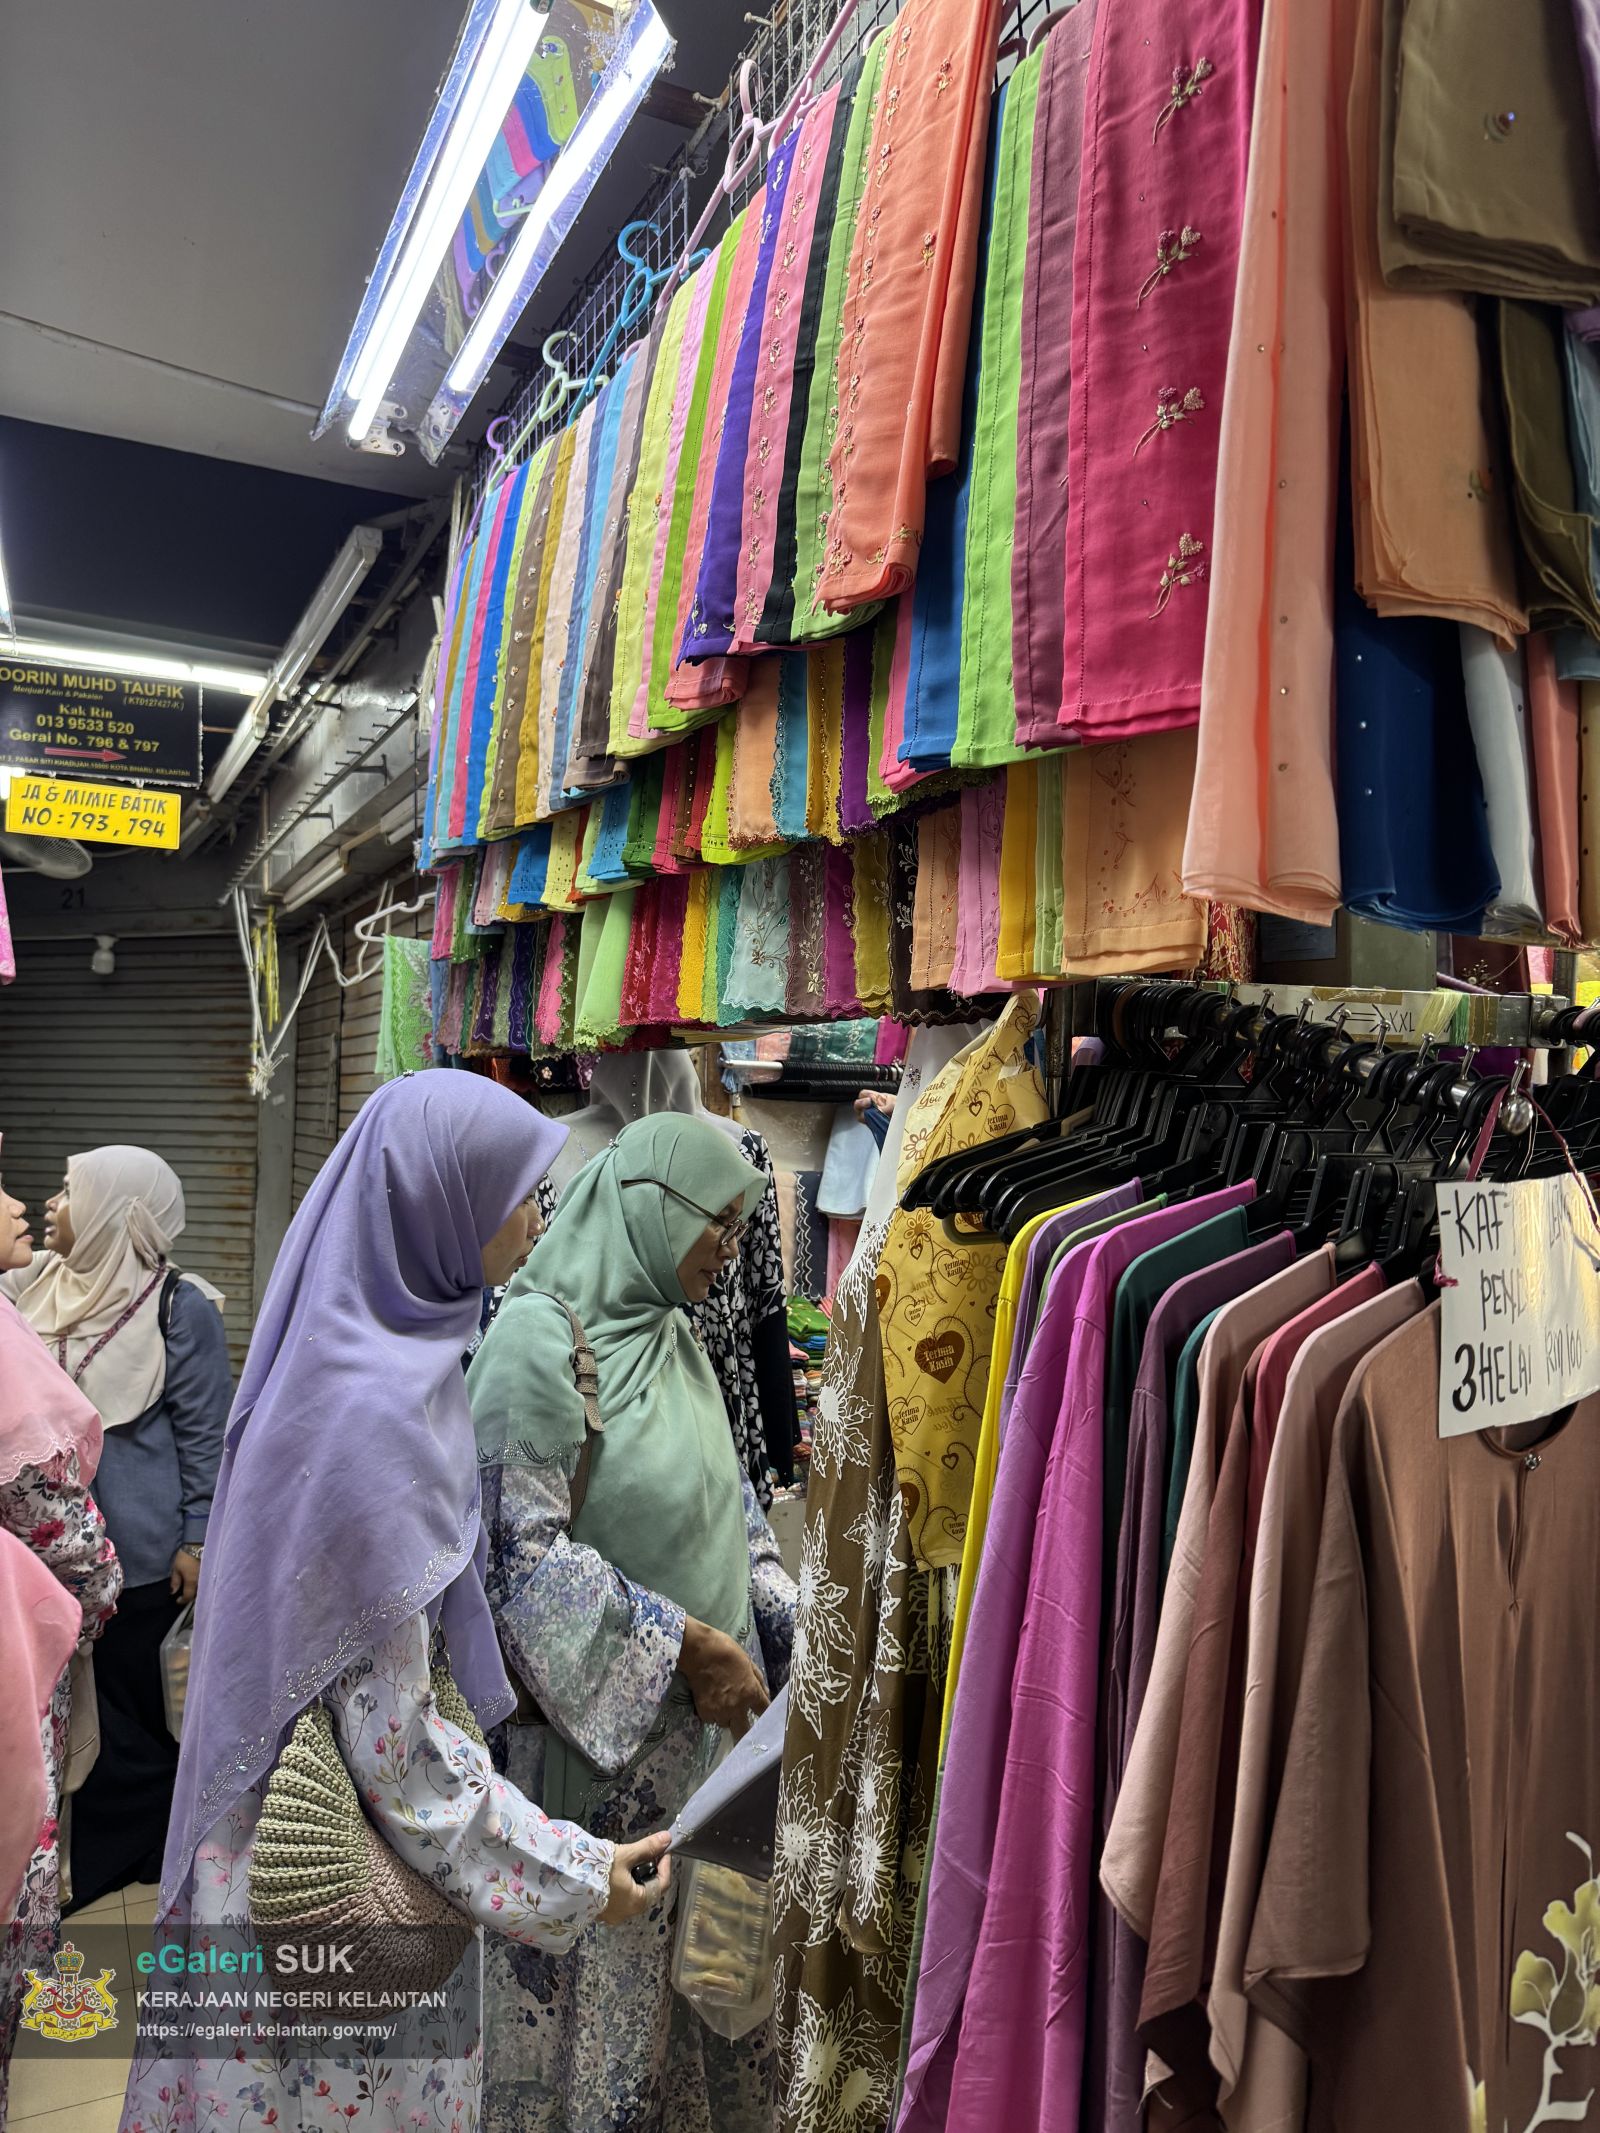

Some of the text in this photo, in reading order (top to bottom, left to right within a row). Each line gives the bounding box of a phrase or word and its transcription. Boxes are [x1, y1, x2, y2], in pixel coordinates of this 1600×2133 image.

[63, 673, 117, 692] MUHD
[121, 680, 184, 699] TAUFIK
[59, 704, 113, 718] Kak Rin
[36, 714, 134, 735] 013 9533 520
[8, 729, 160, 753] Gerai No. 796 & 797
[22, 785, 167, 815] JA & MIMIE BATIK
[129, 818, 165, 838] 794
[61, 887, 85, 910] 21
[924, 1345, 955, 1362] Terima
[929, 1357, 954, 1372] Kasih
